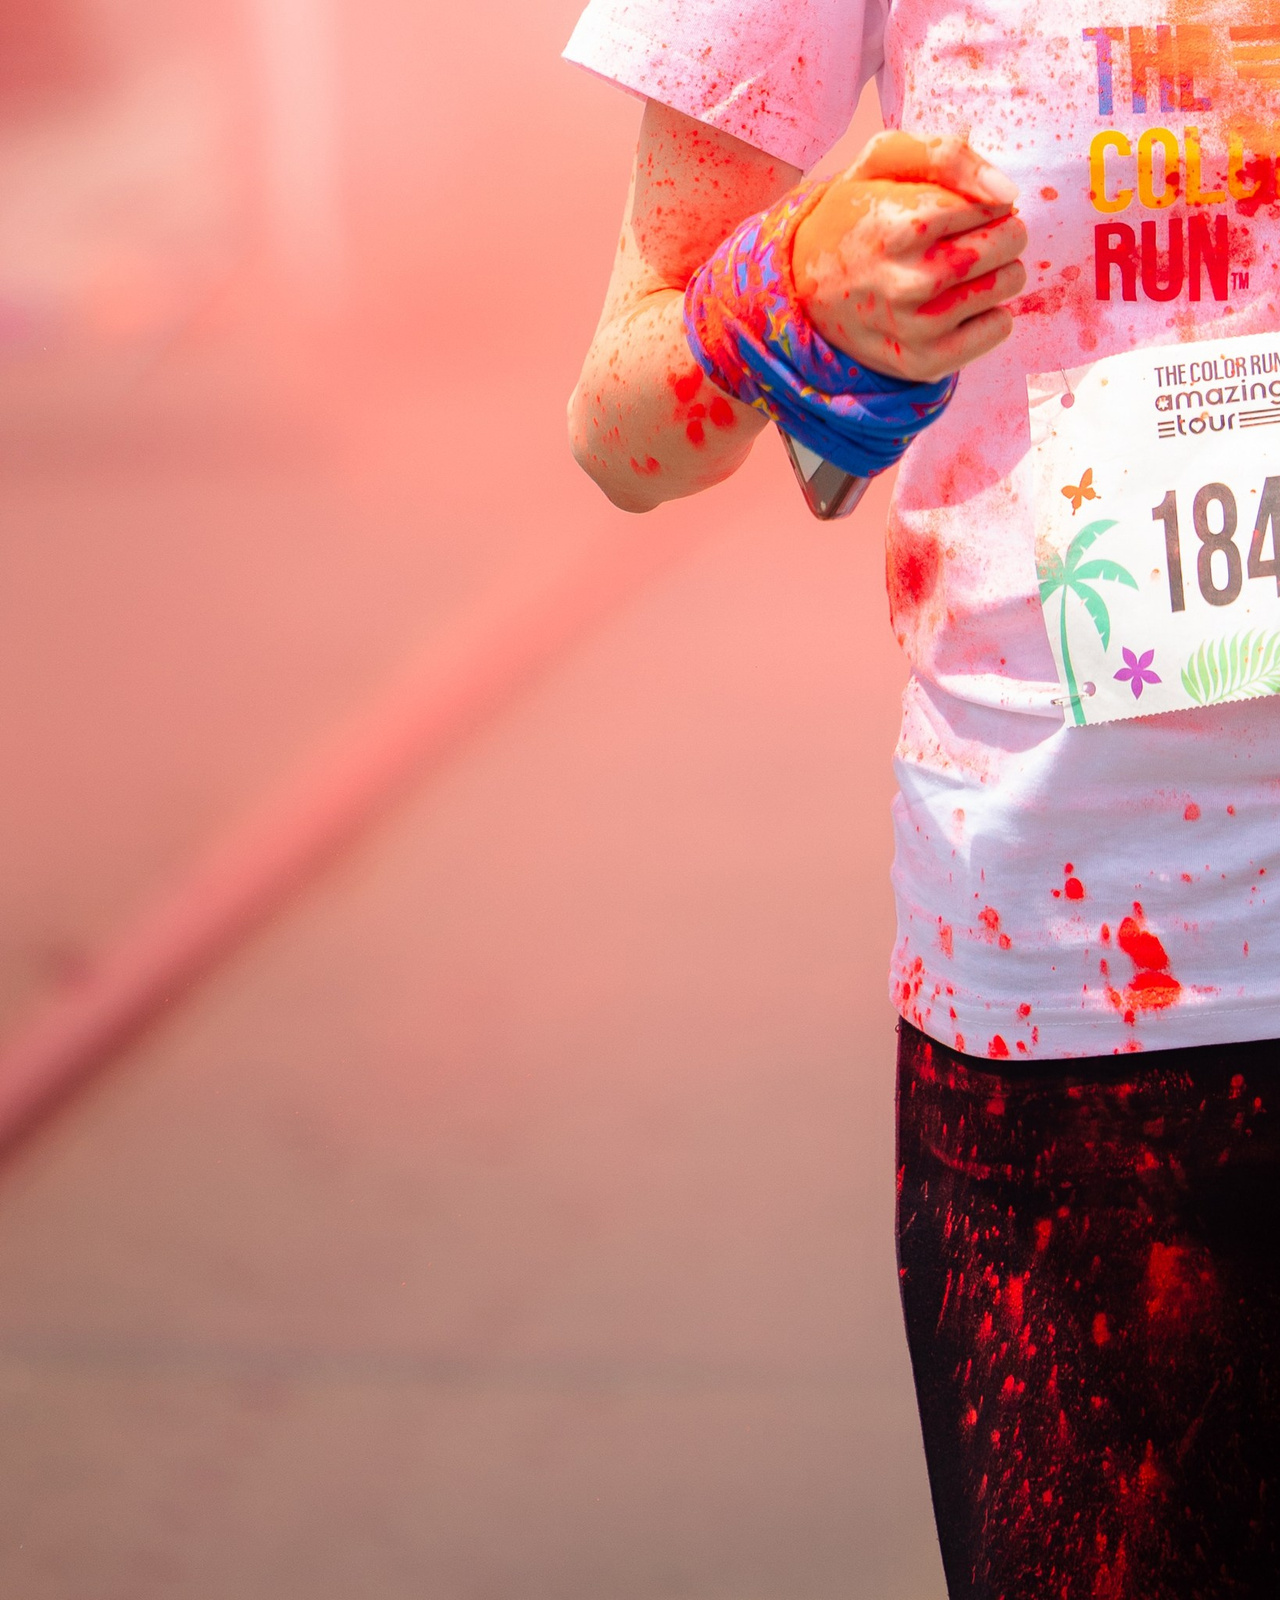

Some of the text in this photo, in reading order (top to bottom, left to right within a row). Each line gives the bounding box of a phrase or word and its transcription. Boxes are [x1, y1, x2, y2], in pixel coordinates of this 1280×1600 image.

[1082, 24, 1212, 116] THE
[1094, 214, 1229, 302] RUN
[1154, 364, 1187, 388] THE
[1189, 356, 1247, 384] COLOR
[1177, 413, 1236, 436] tour
